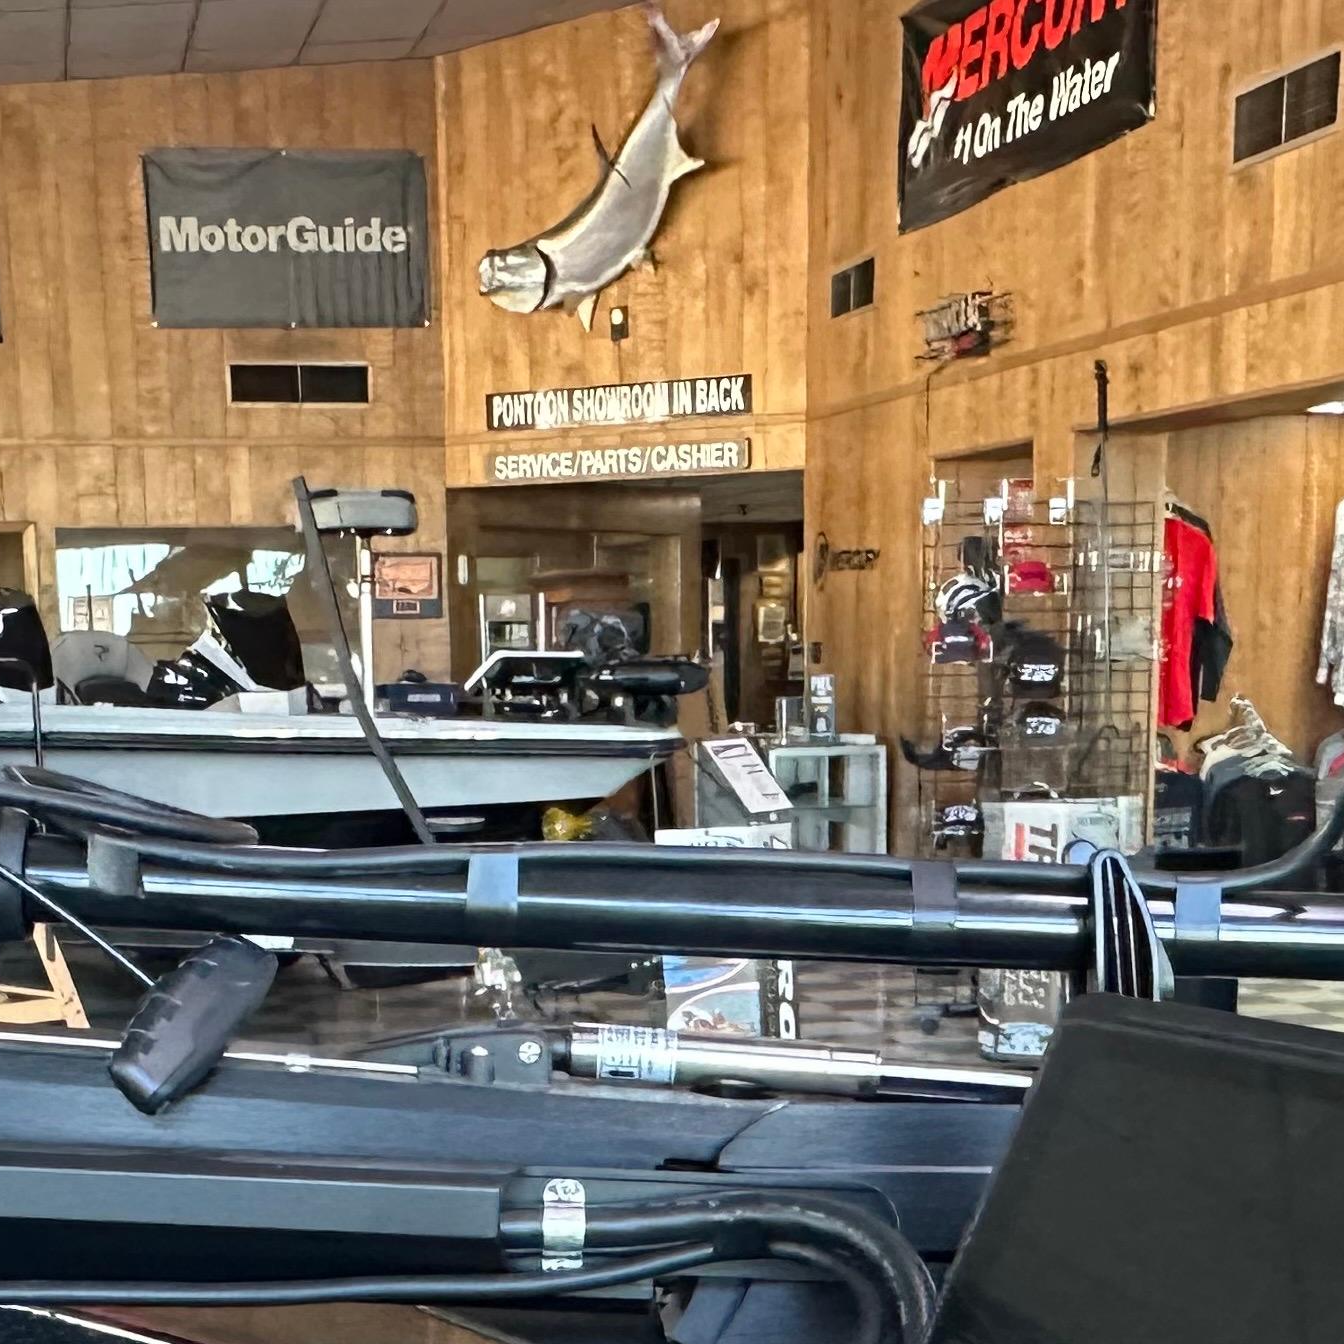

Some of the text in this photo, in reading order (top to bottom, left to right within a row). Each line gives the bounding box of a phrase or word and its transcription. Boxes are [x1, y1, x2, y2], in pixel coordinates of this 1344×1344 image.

[974, 113, 1001, 158] On
[1006, 93, 1044, 143] The
[1049, 52, 1120, 121] Water
[159, 215, 407, 252] MotorGuide
[492, 376, 745, 429] PONTOON SHOWROOM IN BACK
[494, 441, 739, 480] SERVICE/PARTS/CASHIER
